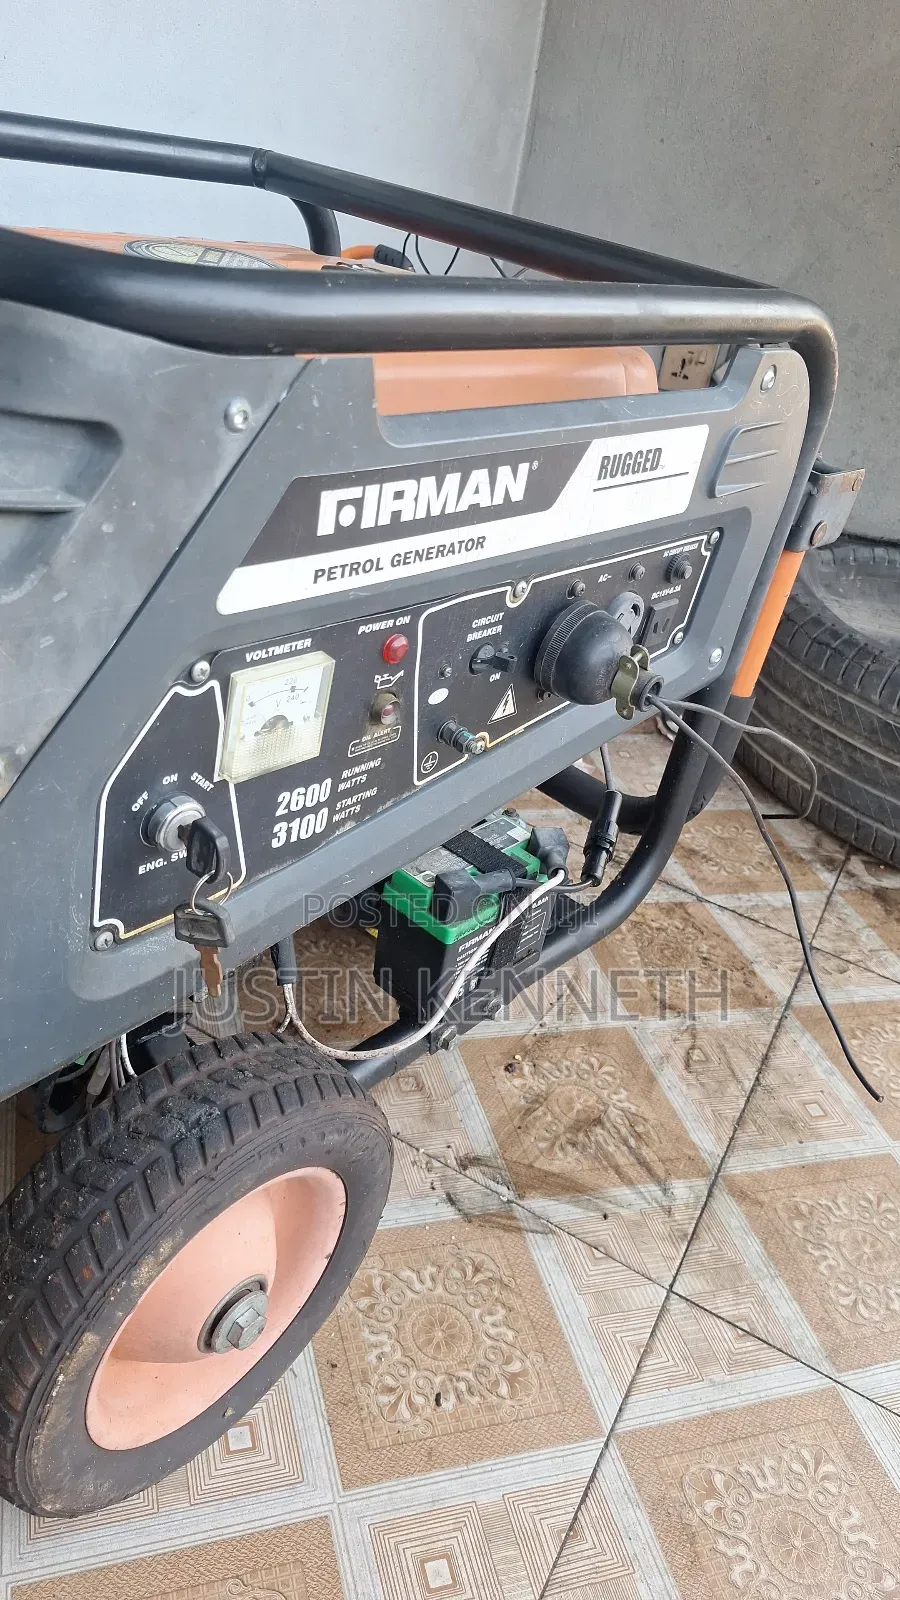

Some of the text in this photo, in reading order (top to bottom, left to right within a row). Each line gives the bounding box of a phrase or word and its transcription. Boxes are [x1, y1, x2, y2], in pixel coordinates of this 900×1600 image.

[597, 447, 663, 481] RUGGED
[316, 462, 530, 537] FIRMAN
[313, 535, 486, 584] PETROL GENERATOR
[357, 614, 411, 635] POWER ON
[472, 612, 504, 628] CIRCUIT
[466, 625, 503, 643] BREAKER
[245, 637, 312, 663] VOLTMETER
[489, 672, 501, 683] ON
[162, 773, 178, 785] ON
[341, 757, 382, 780] RUNNING
[190, 772, 214, 792] START
[337, 773, 367, 793] WATTS
[131, 791, 149, 812] OFF
[274, 777, 333, 817] 2600
[335, 787, 378, 811] STARTING
[332, 804, 361, 823] WATTS
[271, 807, 329, 849] 3100
[138, 858, 168, 875] ENG.
